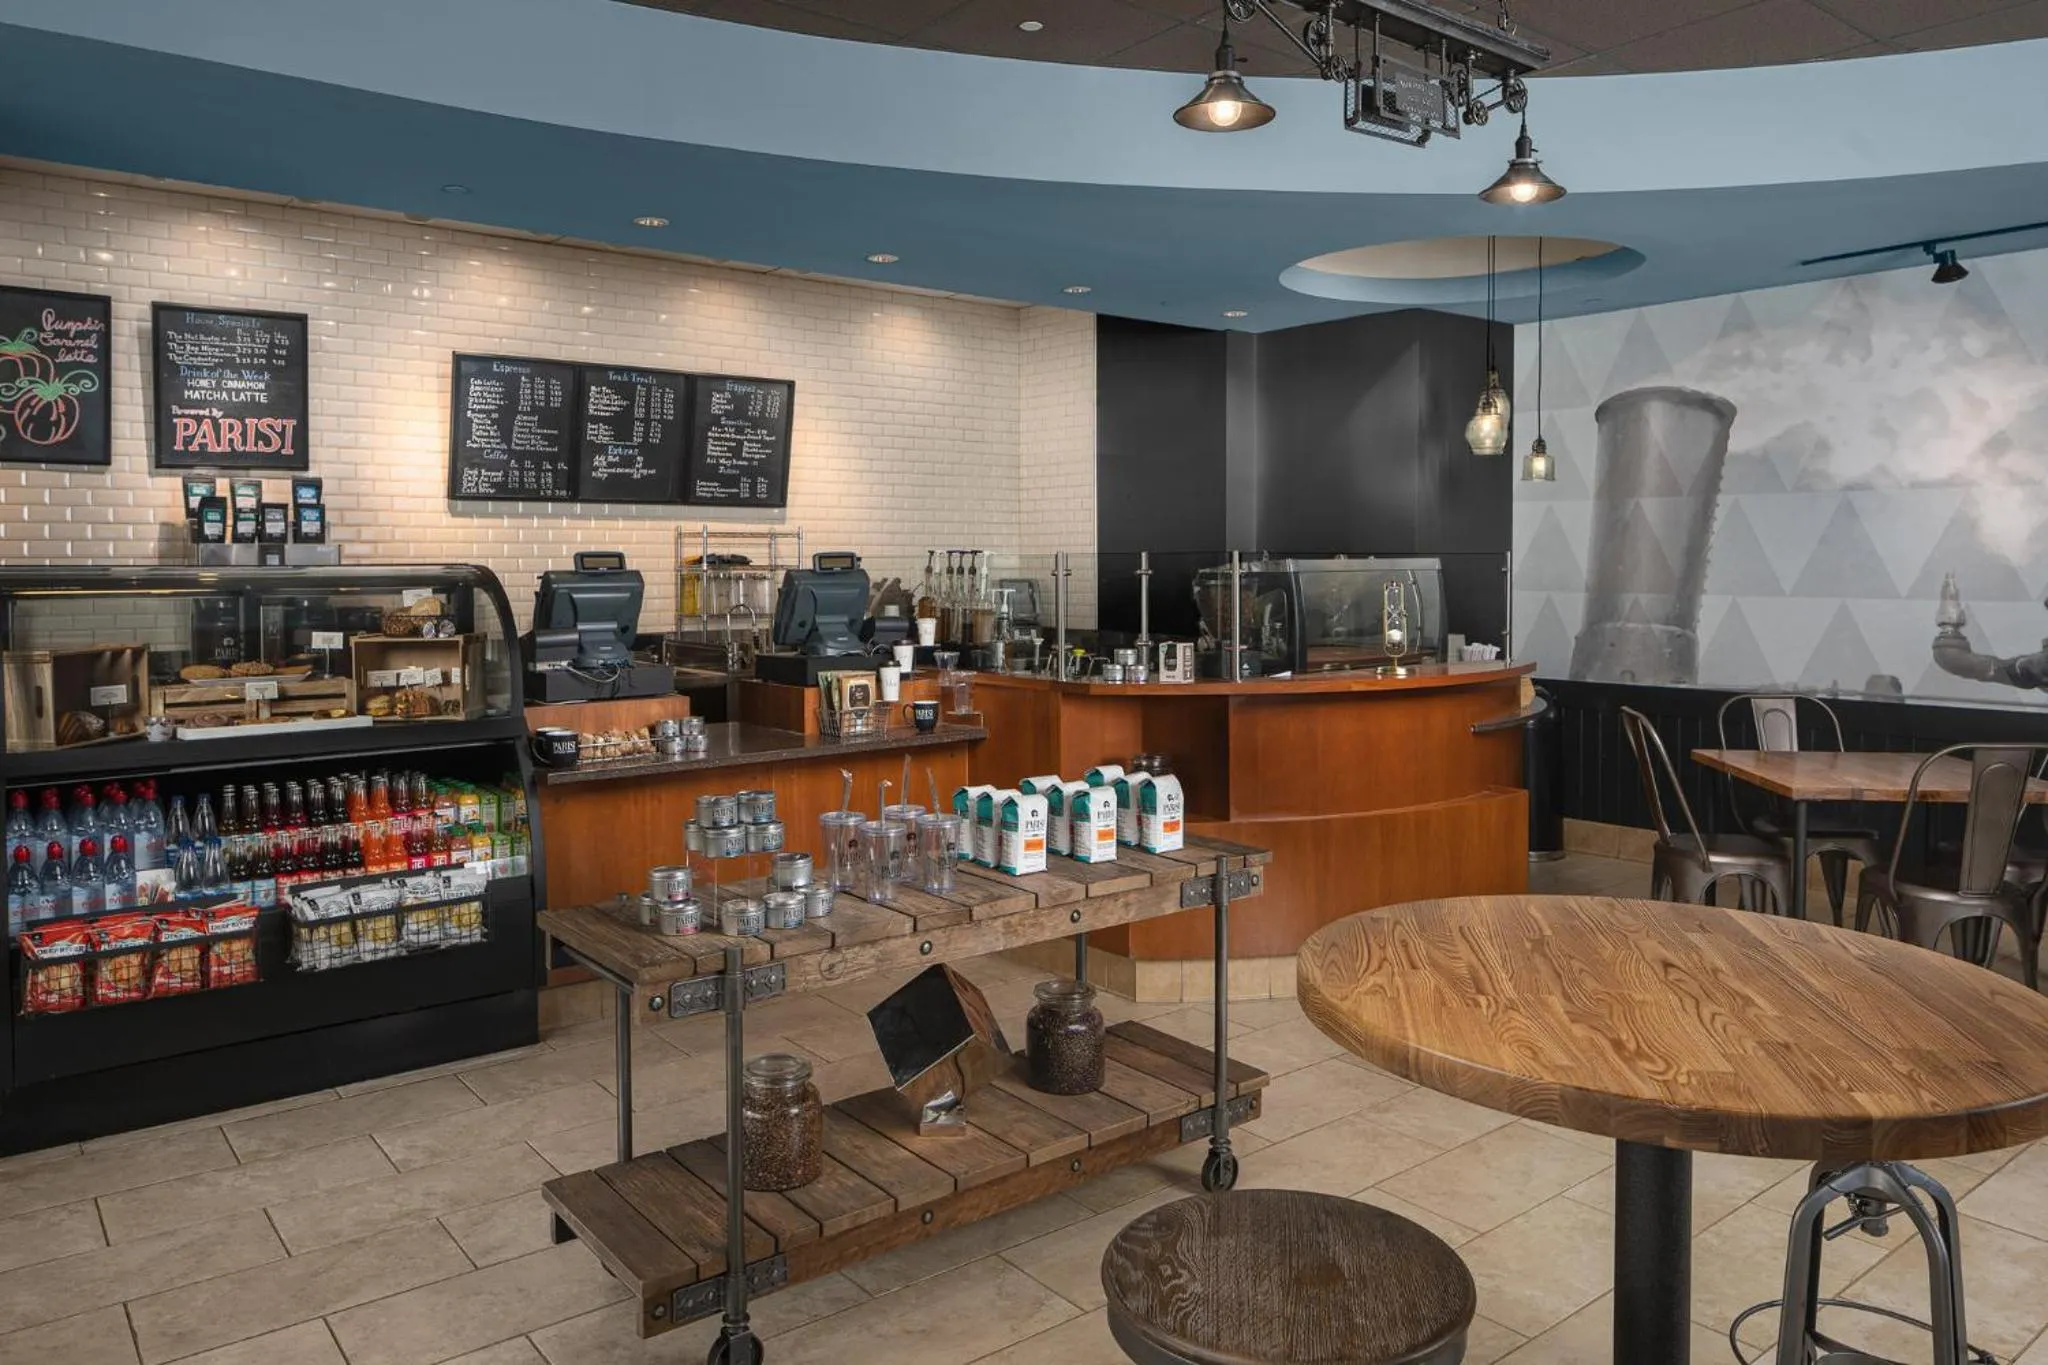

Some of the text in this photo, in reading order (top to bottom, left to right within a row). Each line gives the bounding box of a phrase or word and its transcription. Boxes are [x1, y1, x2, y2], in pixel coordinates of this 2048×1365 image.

[40, 332, 98, 349] Caramel
[187, 379, 266, 391] HONEY CINNAMON
[184, 390, 269, 403] MATCHA LATTE
[173, 418, 297, 455] PARISI
